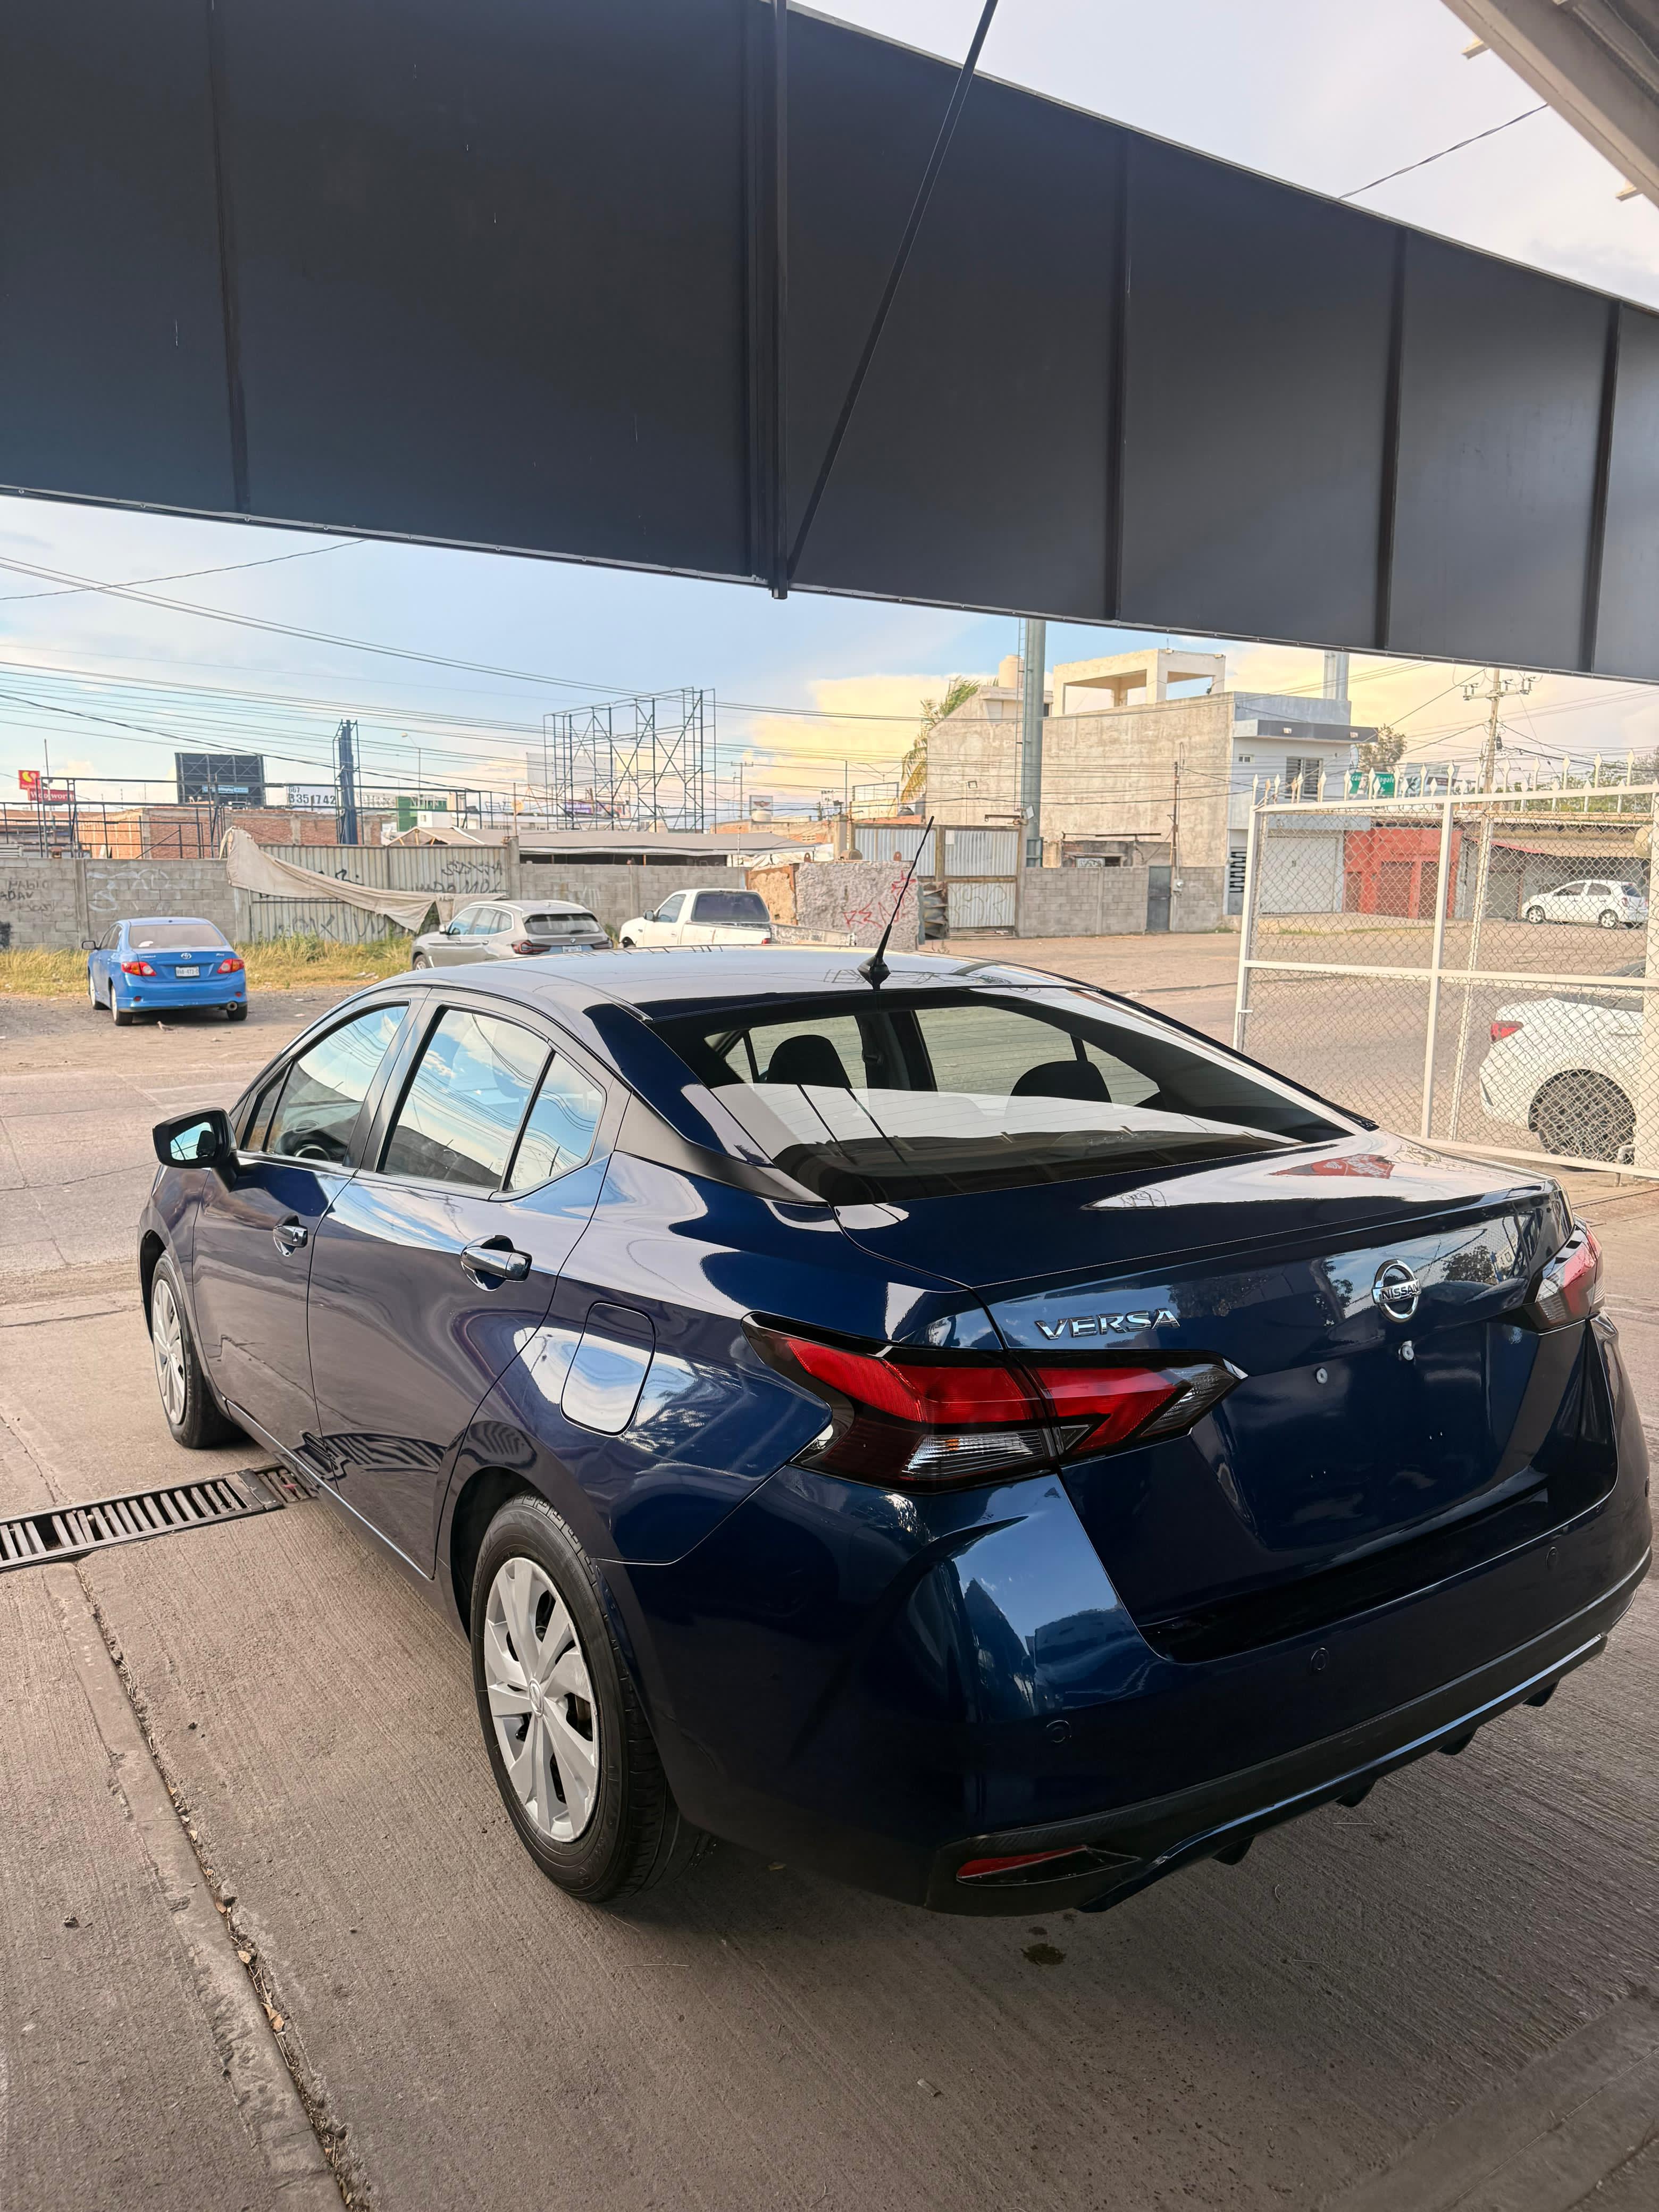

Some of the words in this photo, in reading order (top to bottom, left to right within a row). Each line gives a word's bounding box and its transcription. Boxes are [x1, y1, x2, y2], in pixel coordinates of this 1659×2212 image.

[30, 790, 74, 800] Wooworh
[1381, 1283, 1420, 1300] NISSAN
[1034, 1308, 1180, 1340] VERSA
